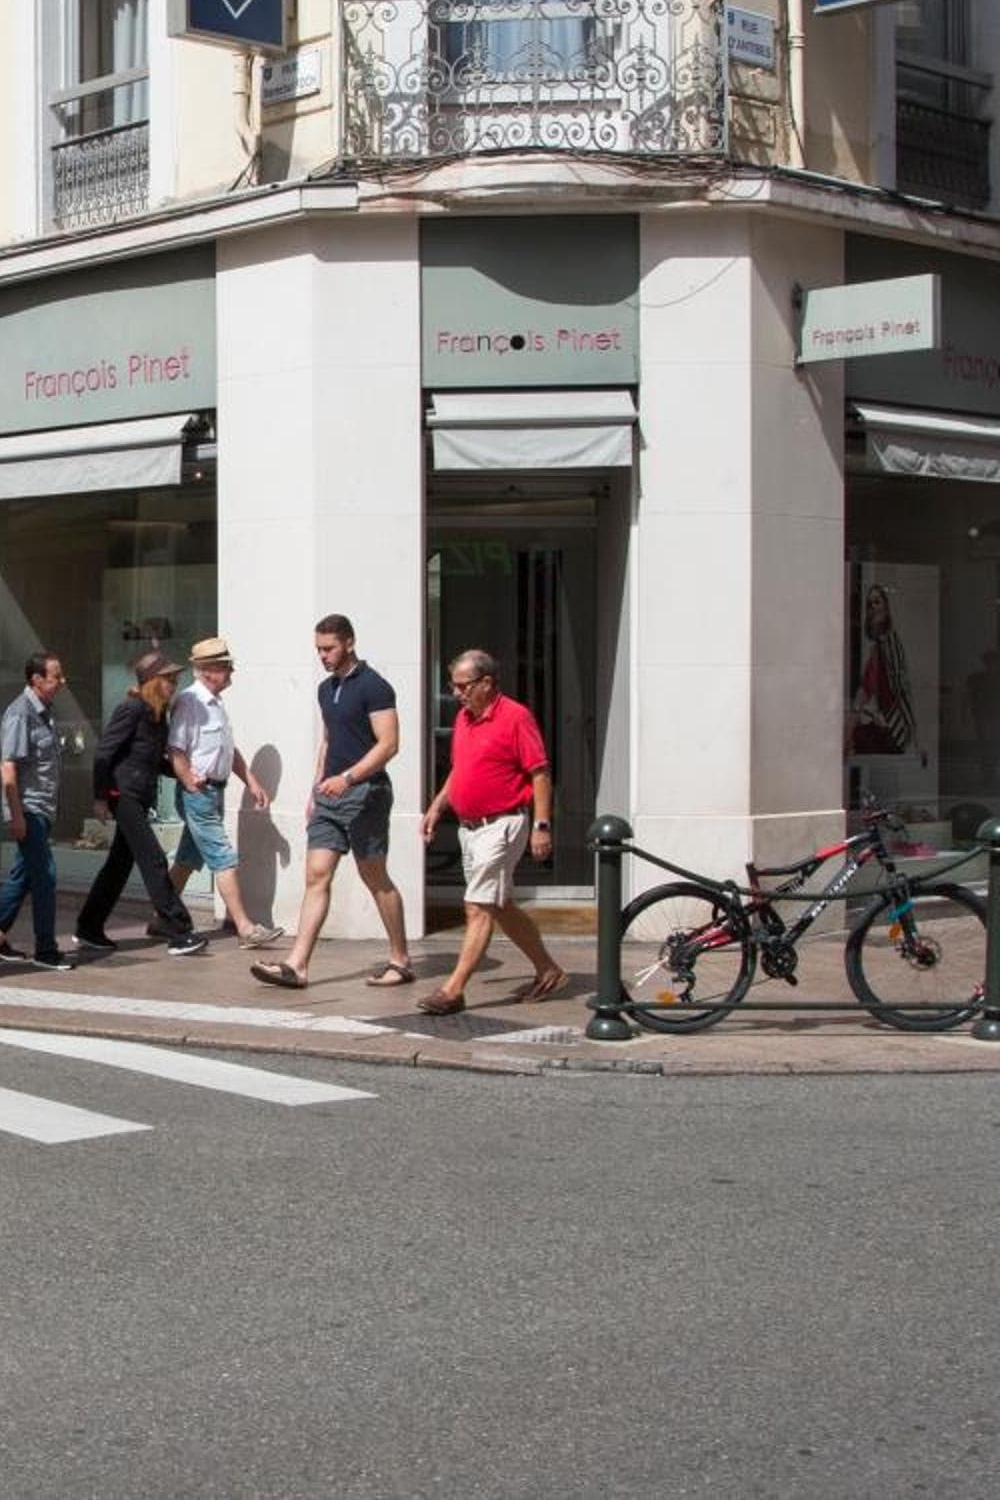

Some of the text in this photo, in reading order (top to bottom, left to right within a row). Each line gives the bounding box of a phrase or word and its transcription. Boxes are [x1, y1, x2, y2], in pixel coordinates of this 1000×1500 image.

[556, 327, 622, 352] Pinet
[812, 318, 921, 347] François Pinet
[24, 347, 190, 401] François Pinet
